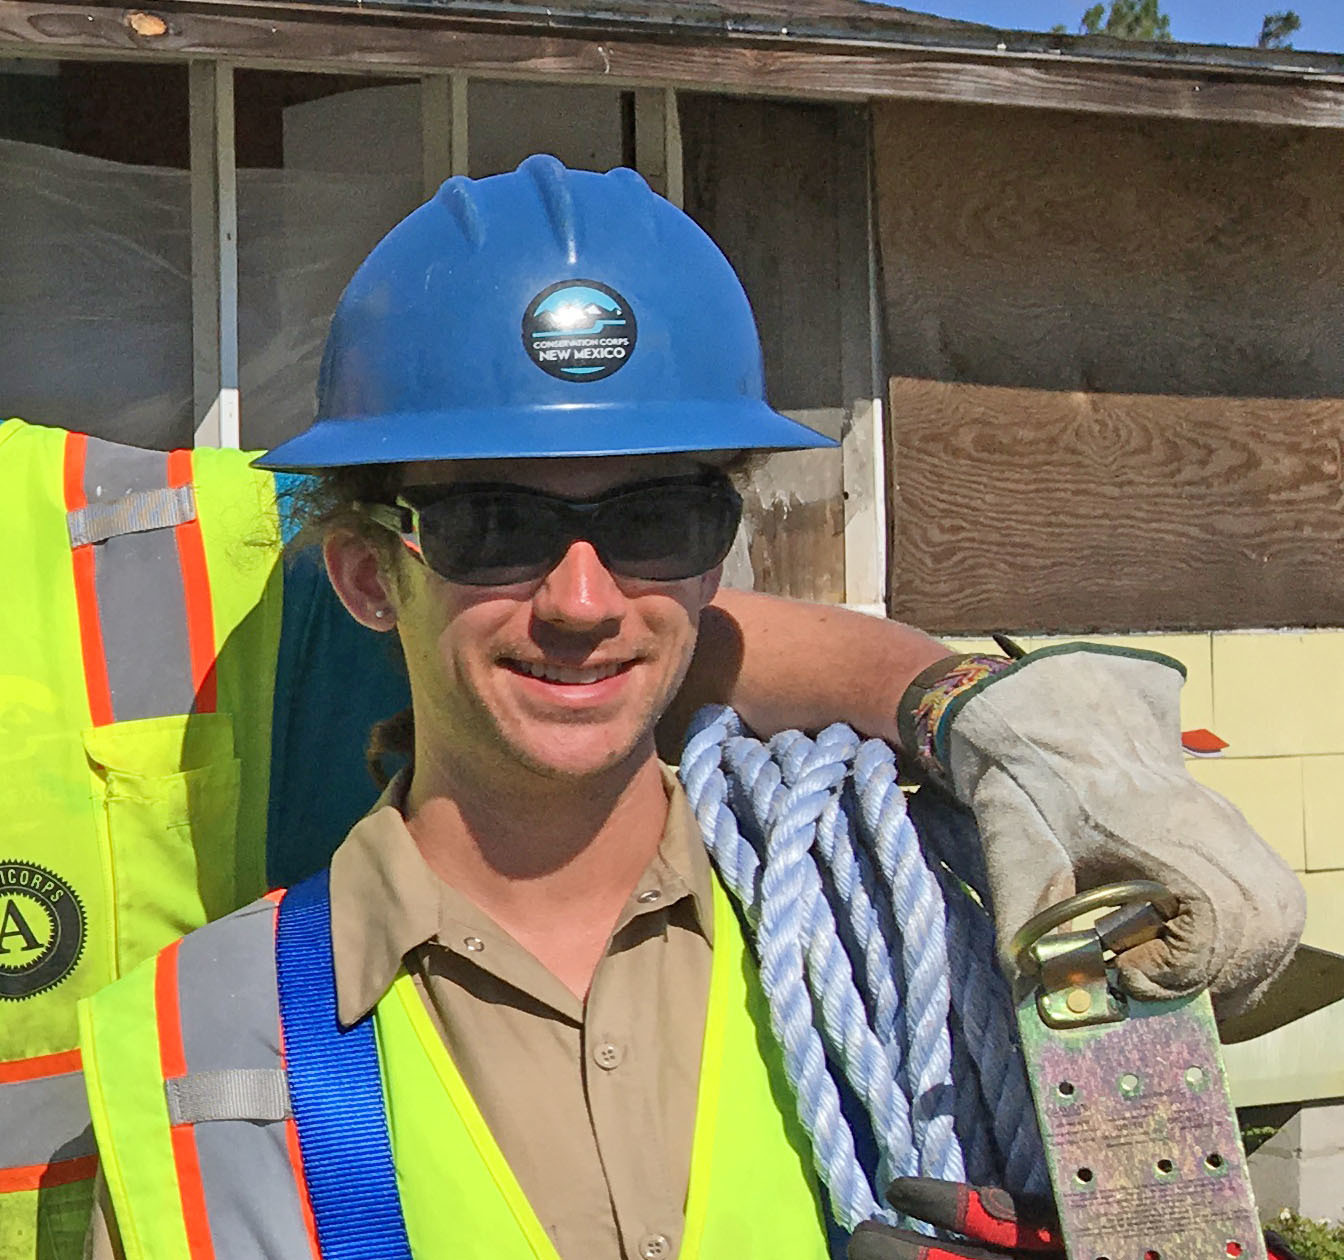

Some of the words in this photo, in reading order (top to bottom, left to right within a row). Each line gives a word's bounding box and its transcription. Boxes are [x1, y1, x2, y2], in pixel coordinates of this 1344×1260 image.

[532, 338, 599, 349] CONSERVATION
[599, 337, 630, 346] CORPS
[539, 348, 571, 362] NEW
[573, 347, 626, 360] MEXICO
